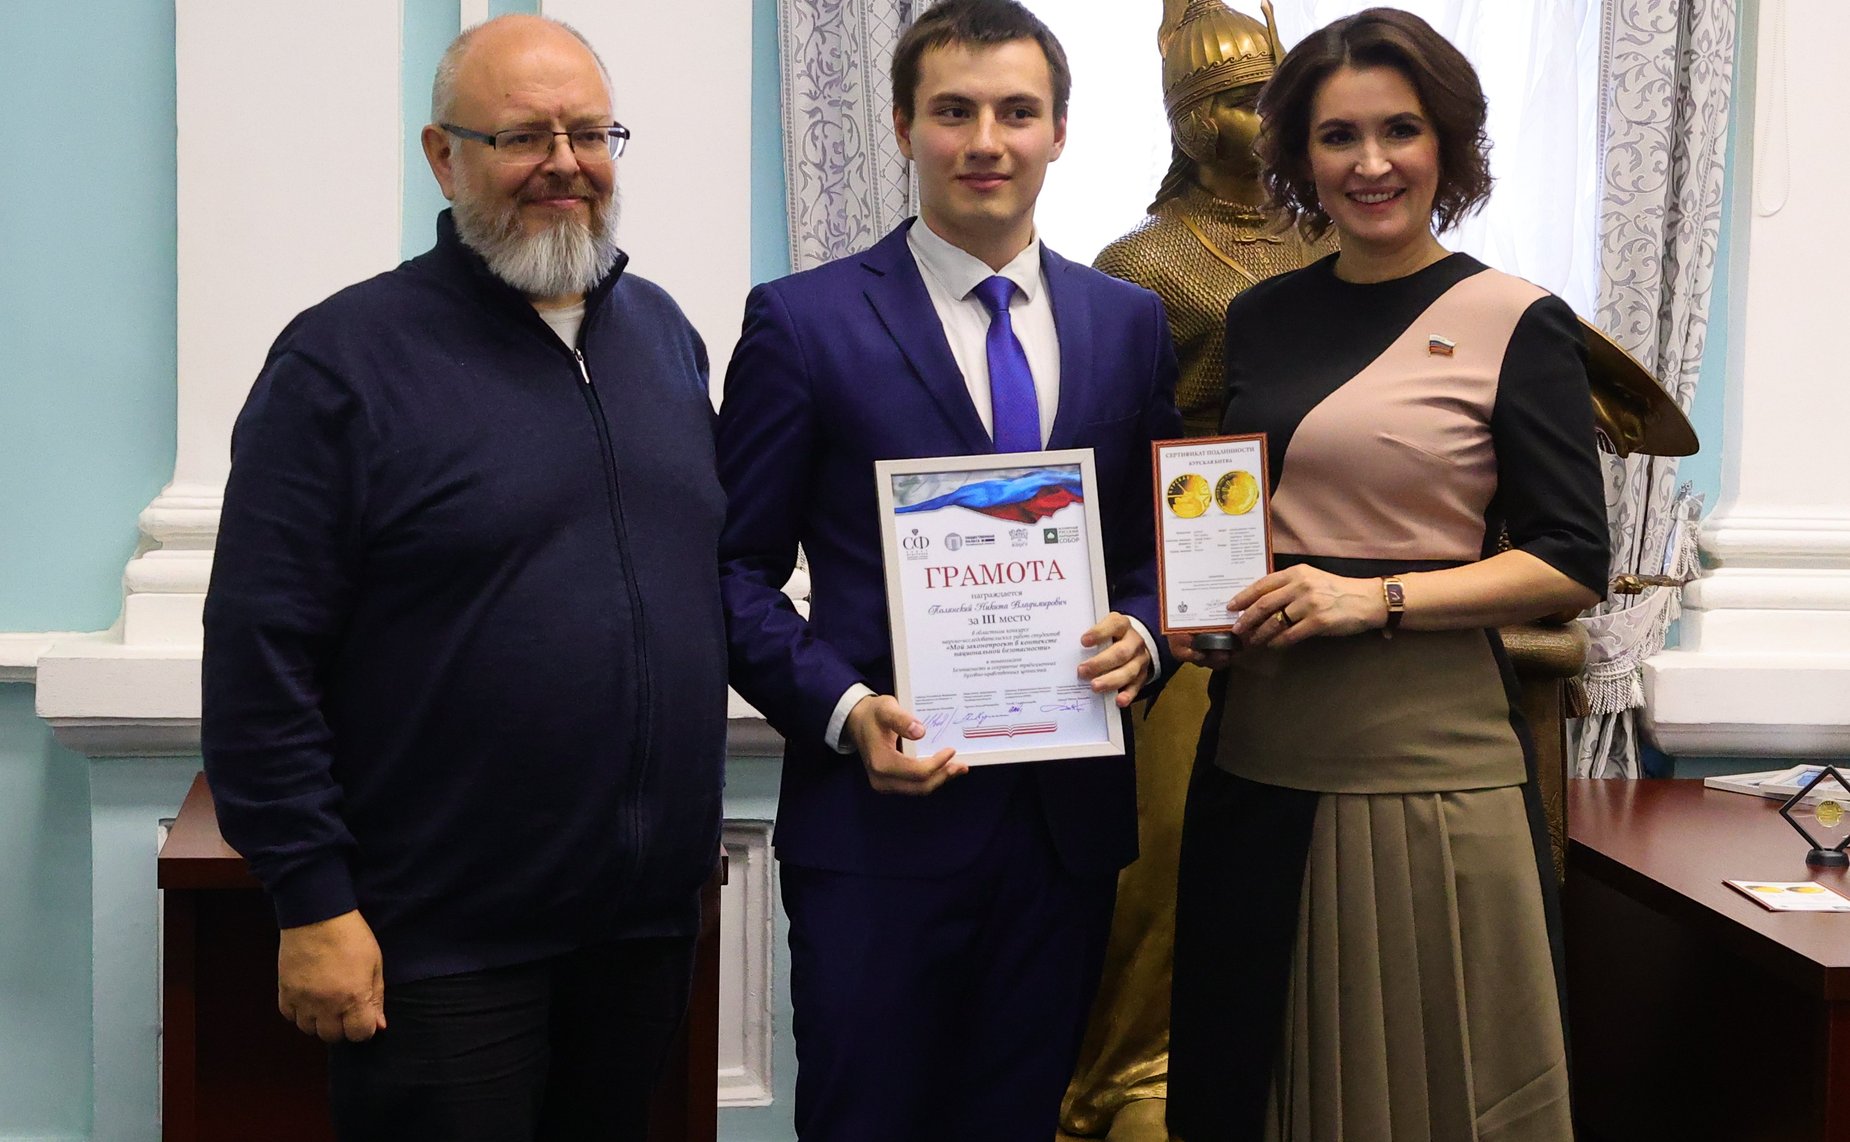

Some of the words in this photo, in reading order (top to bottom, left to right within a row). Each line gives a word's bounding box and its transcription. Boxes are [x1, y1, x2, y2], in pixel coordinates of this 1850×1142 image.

[1165, 450, 1206, 458] СЕРТИФИКАТ
[1206, 447, 1255, 455] ПОДЛИННОСТИ
[903, 536, 930, 550] СФ
[924, 559, 1067, 589] ГРАМОТА
[971, 590, 1023, 601] награждается
[974, 601, 1008, 612] Никита
[1010, 597, 1067, 611] Владимирович
[982, 614, 996, 624] III
[999, 614, 1031, 623] место
[966, 641, 1013, 649] законопроект
[1020, 638, 1057, 646] контексте
[954, 649, 1000, 657] национальной
